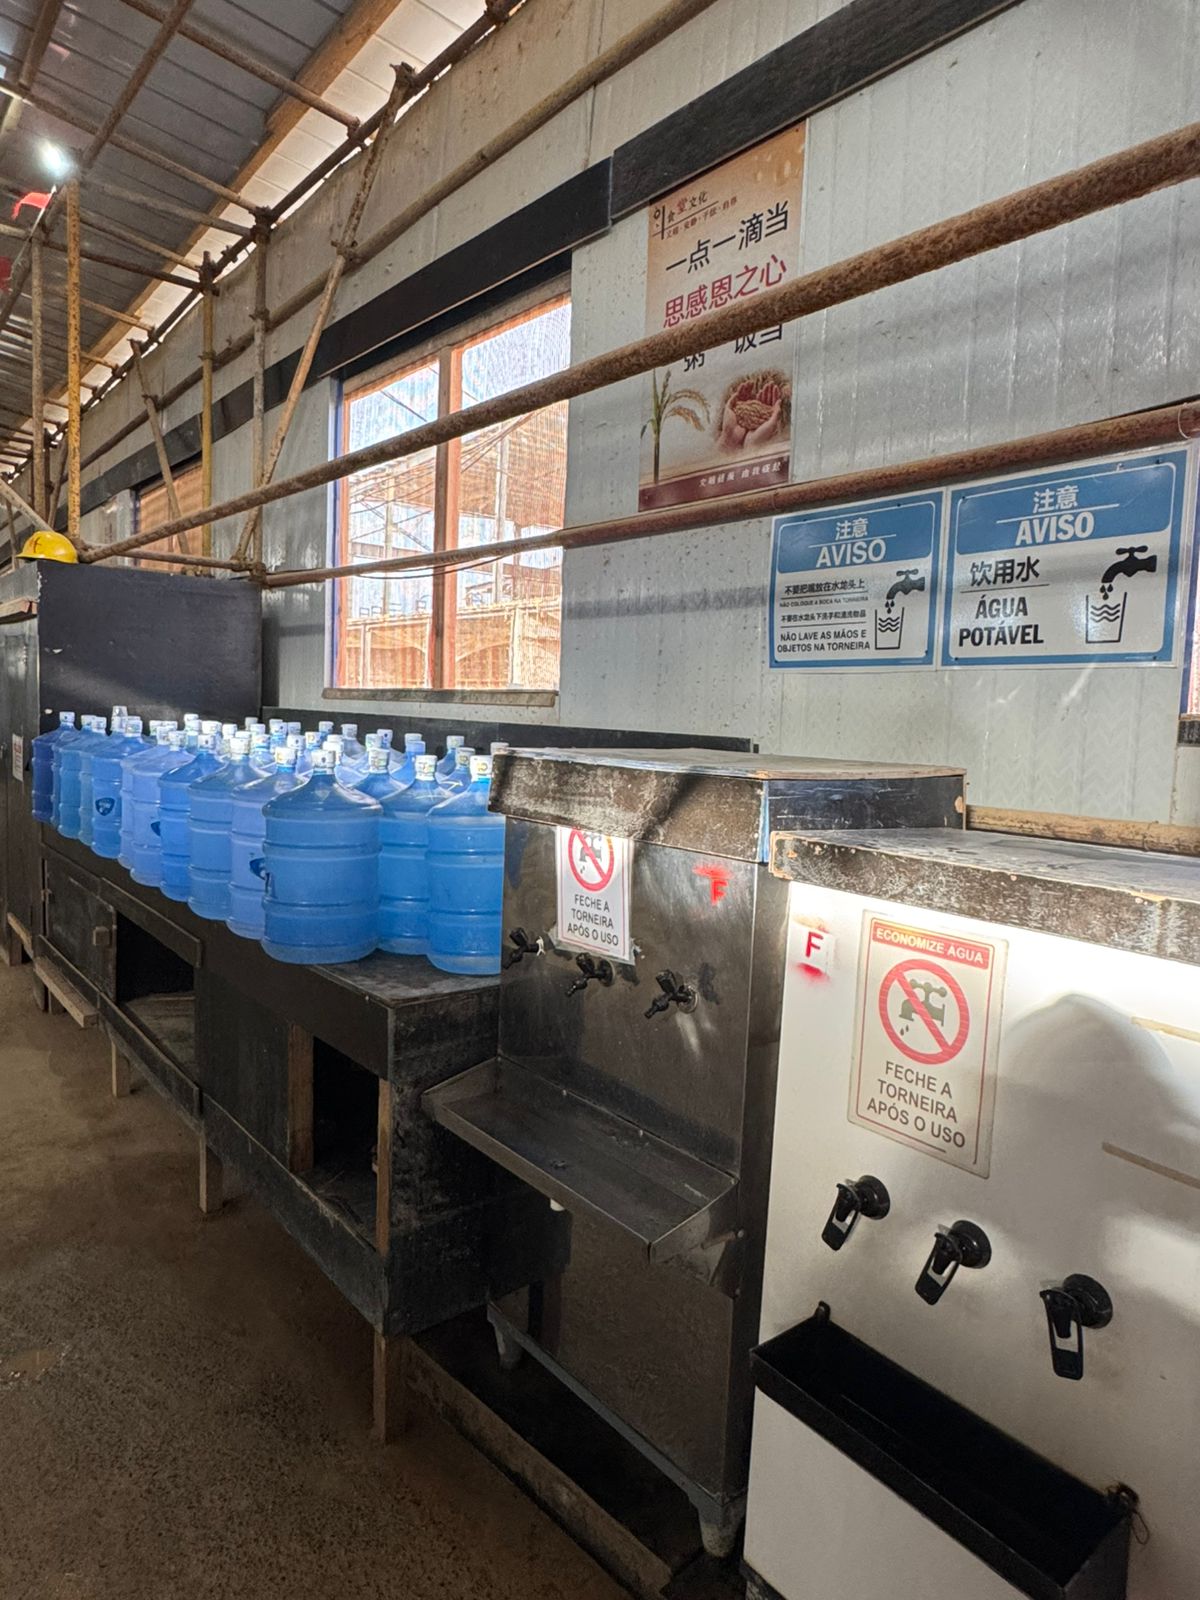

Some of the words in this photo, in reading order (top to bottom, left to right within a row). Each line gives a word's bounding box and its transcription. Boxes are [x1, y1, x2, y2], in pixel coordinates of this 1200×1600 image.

[665, 200, 788, 274] 一点一滴当
[663, 254, 787, 329] 思感恩之心
[1033, 484, 1079, 514] 注意
[835, 517, 869, 541] 注意
[1015, 511, 1095, 546] AVISO
[816, 538, 887, 568] AVISO
[970, 556, 1041, 587] 饮用水
[975, 595, 1028, 620] ÁGUA
[777, 643, 812, 653] OBJETOS
[814, 642, 825, 652] NA
[827, 641, 870, 651] TORNEIRA
[780, 631, 797, 641] NÃO
[799, 631, 819, 641] LAVE
[820, 630, 832, 640] AS
[833, 628, 859, 639] MÃOS
[861, 629, 867, 638] E
[958, 621, 1045, 647] POTÁVEL
[574, 893, 602, 911] FECHE
[603, 900, 610, 912] A
[571, 907, 614, 929] TORNEIRA
[567, 922, 590, 939] APÓS
[591, 928, 599, 940] O
[600, 930, 619, 947] USO
[804, 931, 824, 958] F
[876, 926, 945, 954] ECONOMIZE
[947, 943, 984, 964] ÁGUA
[885, 1060, 937, 1093] FECHE
[940, 1082, 953, 1099] A
[877, 1078, 958, 1124] TORNEIRA
[866, 1096, 910, 1126] APÓS
[914, 1115, 926, 1132] O
[931, 1121, 966, 1148] USO
